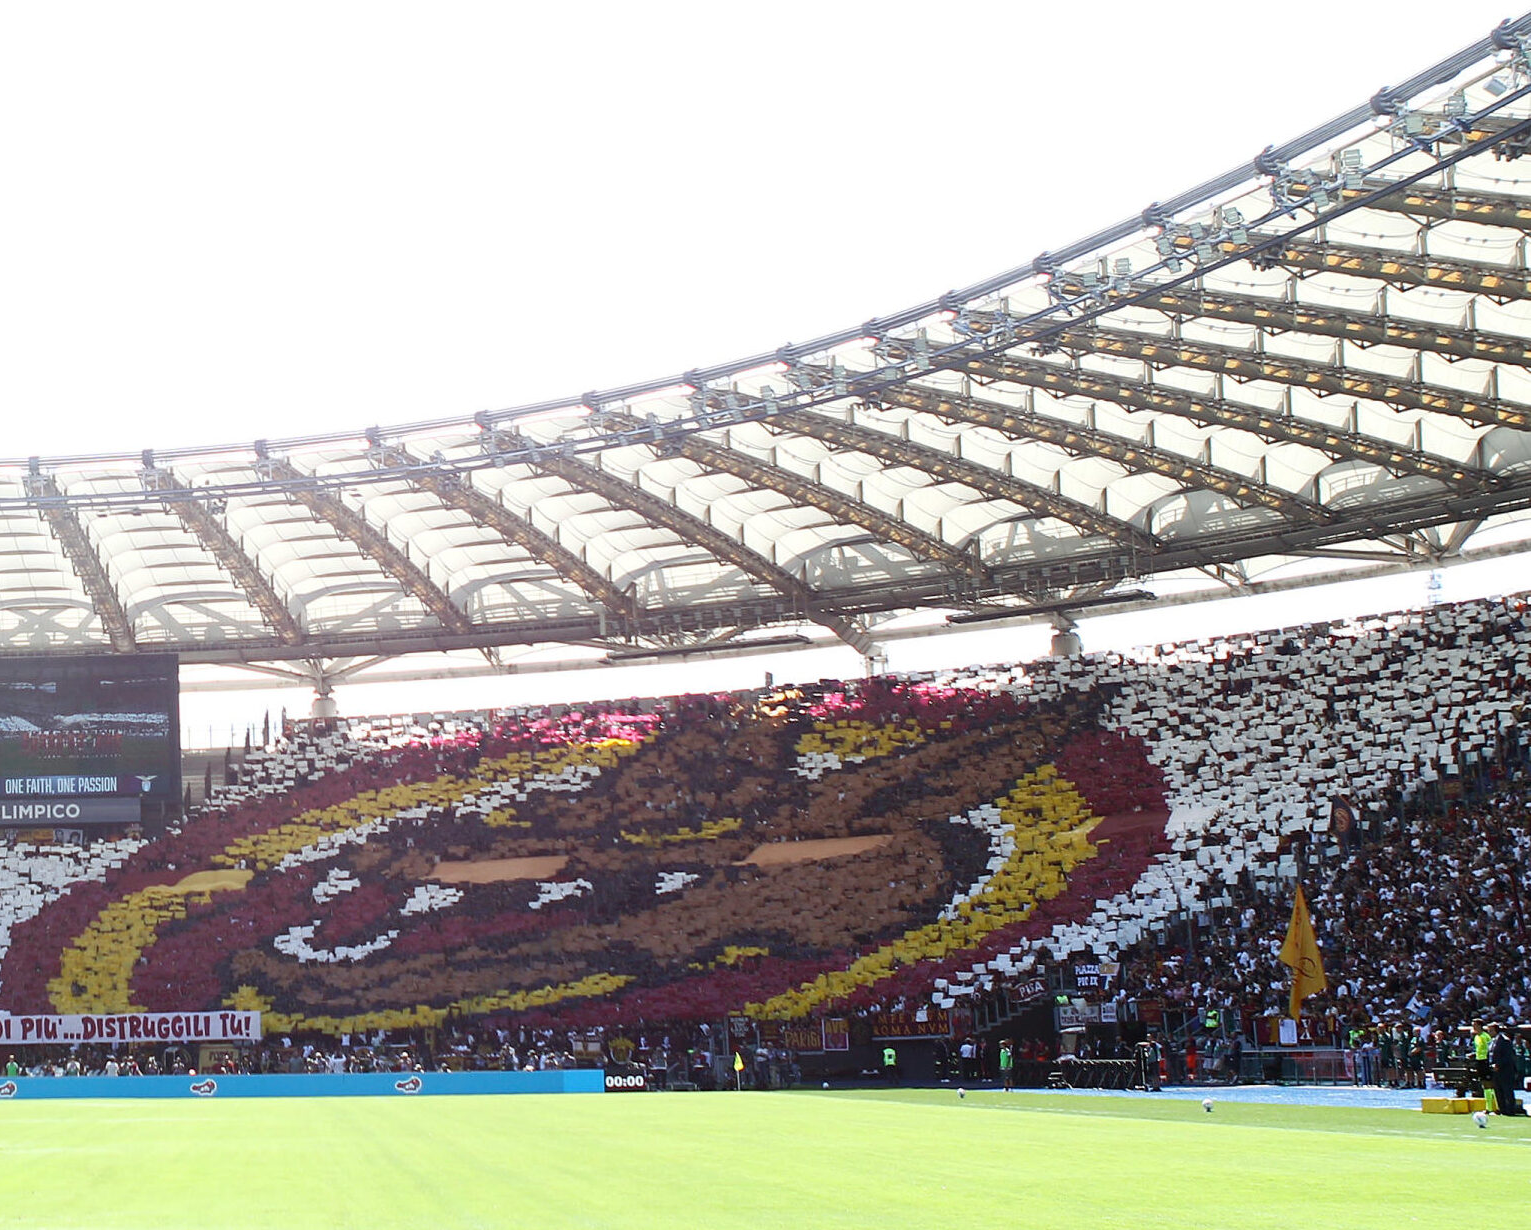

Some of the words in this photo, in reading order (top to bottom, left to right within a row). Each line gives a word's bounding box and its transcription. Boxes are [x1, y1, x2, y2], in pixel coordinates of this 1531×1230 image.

[5, 779, 23, 794] ONE
[26, 778, 55, 796] FAITH,
[57, 778, 76, 794] ONE
[78, 777, 117, 793] PASSION
[221, 1013, 251, 1037] TU!
[605, 1075, 644, 1088] 00:00
